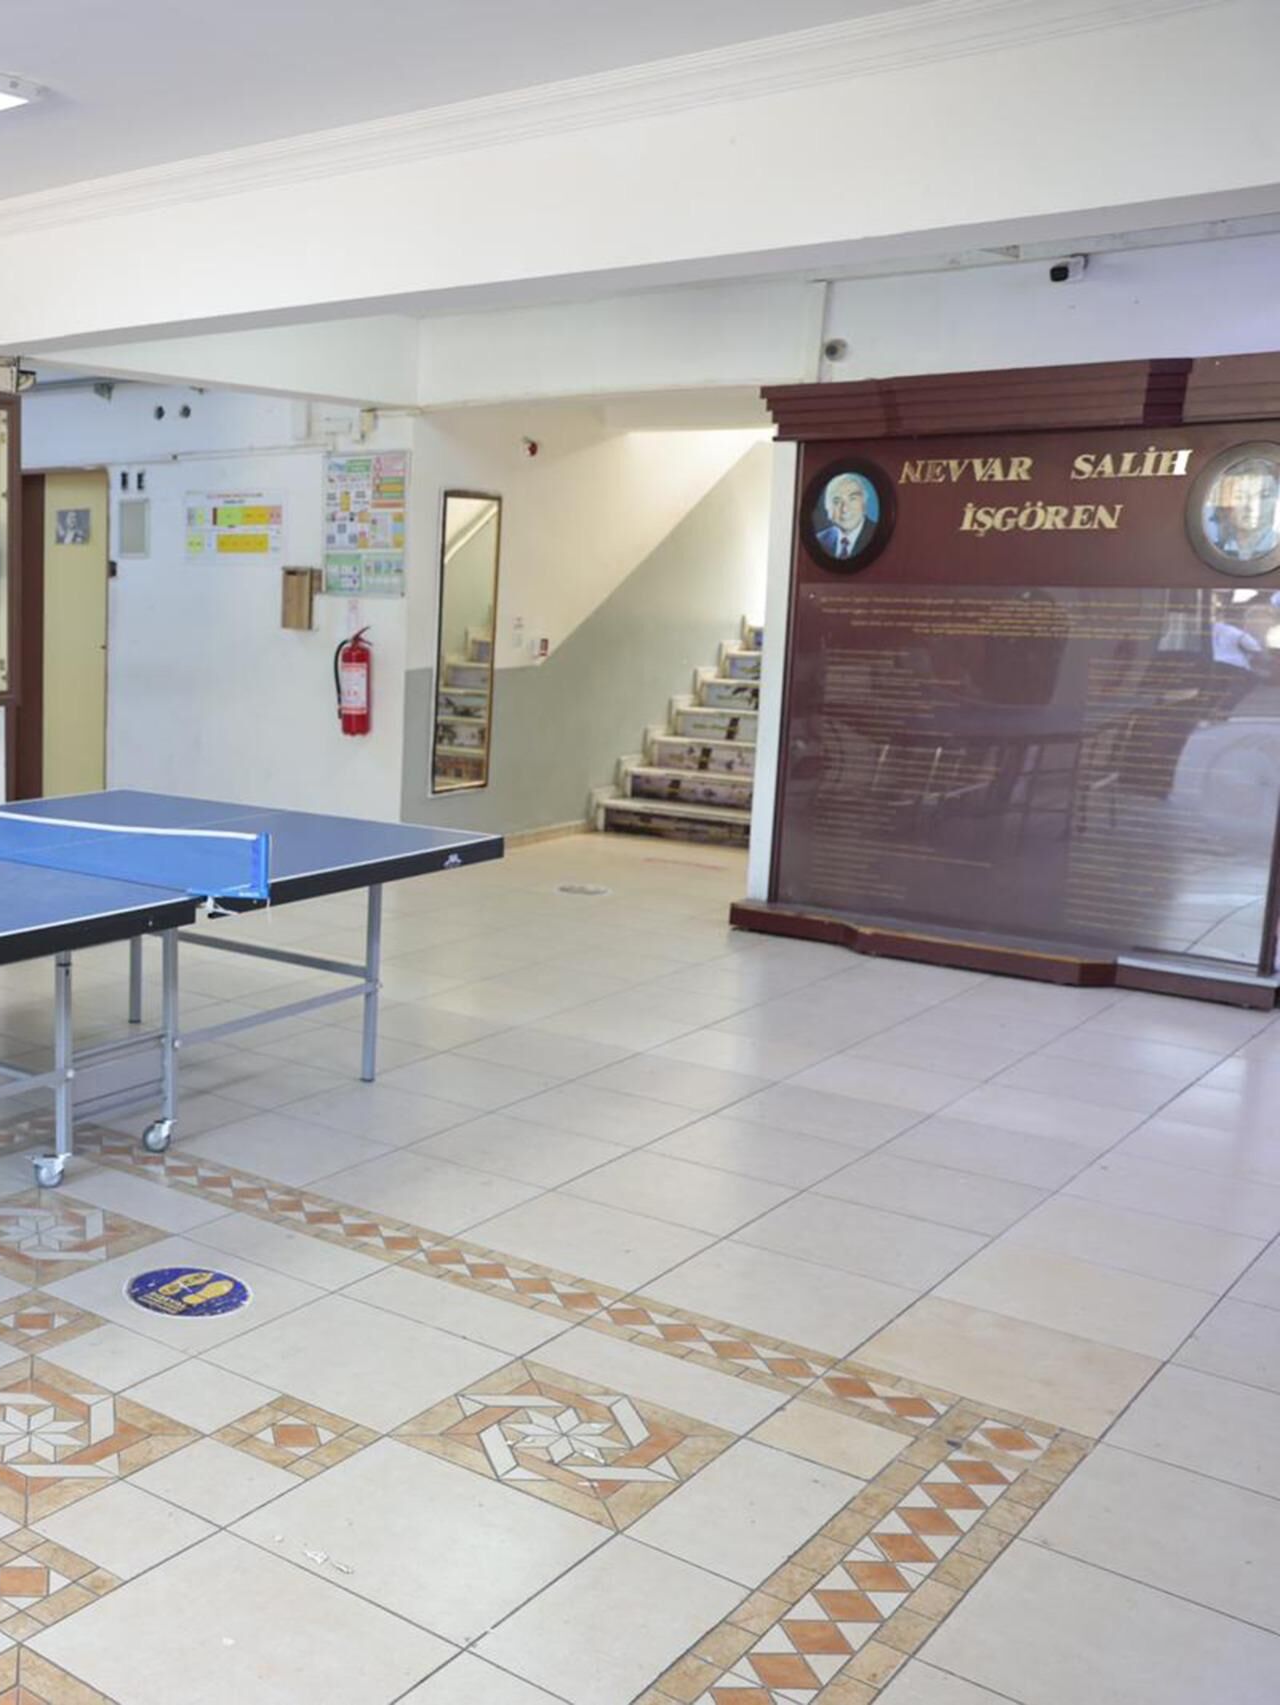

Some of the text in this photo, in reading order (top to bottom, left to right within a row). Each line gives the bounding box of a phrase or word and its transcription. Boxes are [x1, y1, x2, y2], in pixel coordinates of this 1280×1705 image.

[898, 446, 1194, 485] NEVVAR SALİH
[959, 500, 1124, 537] İŞGÖREN
